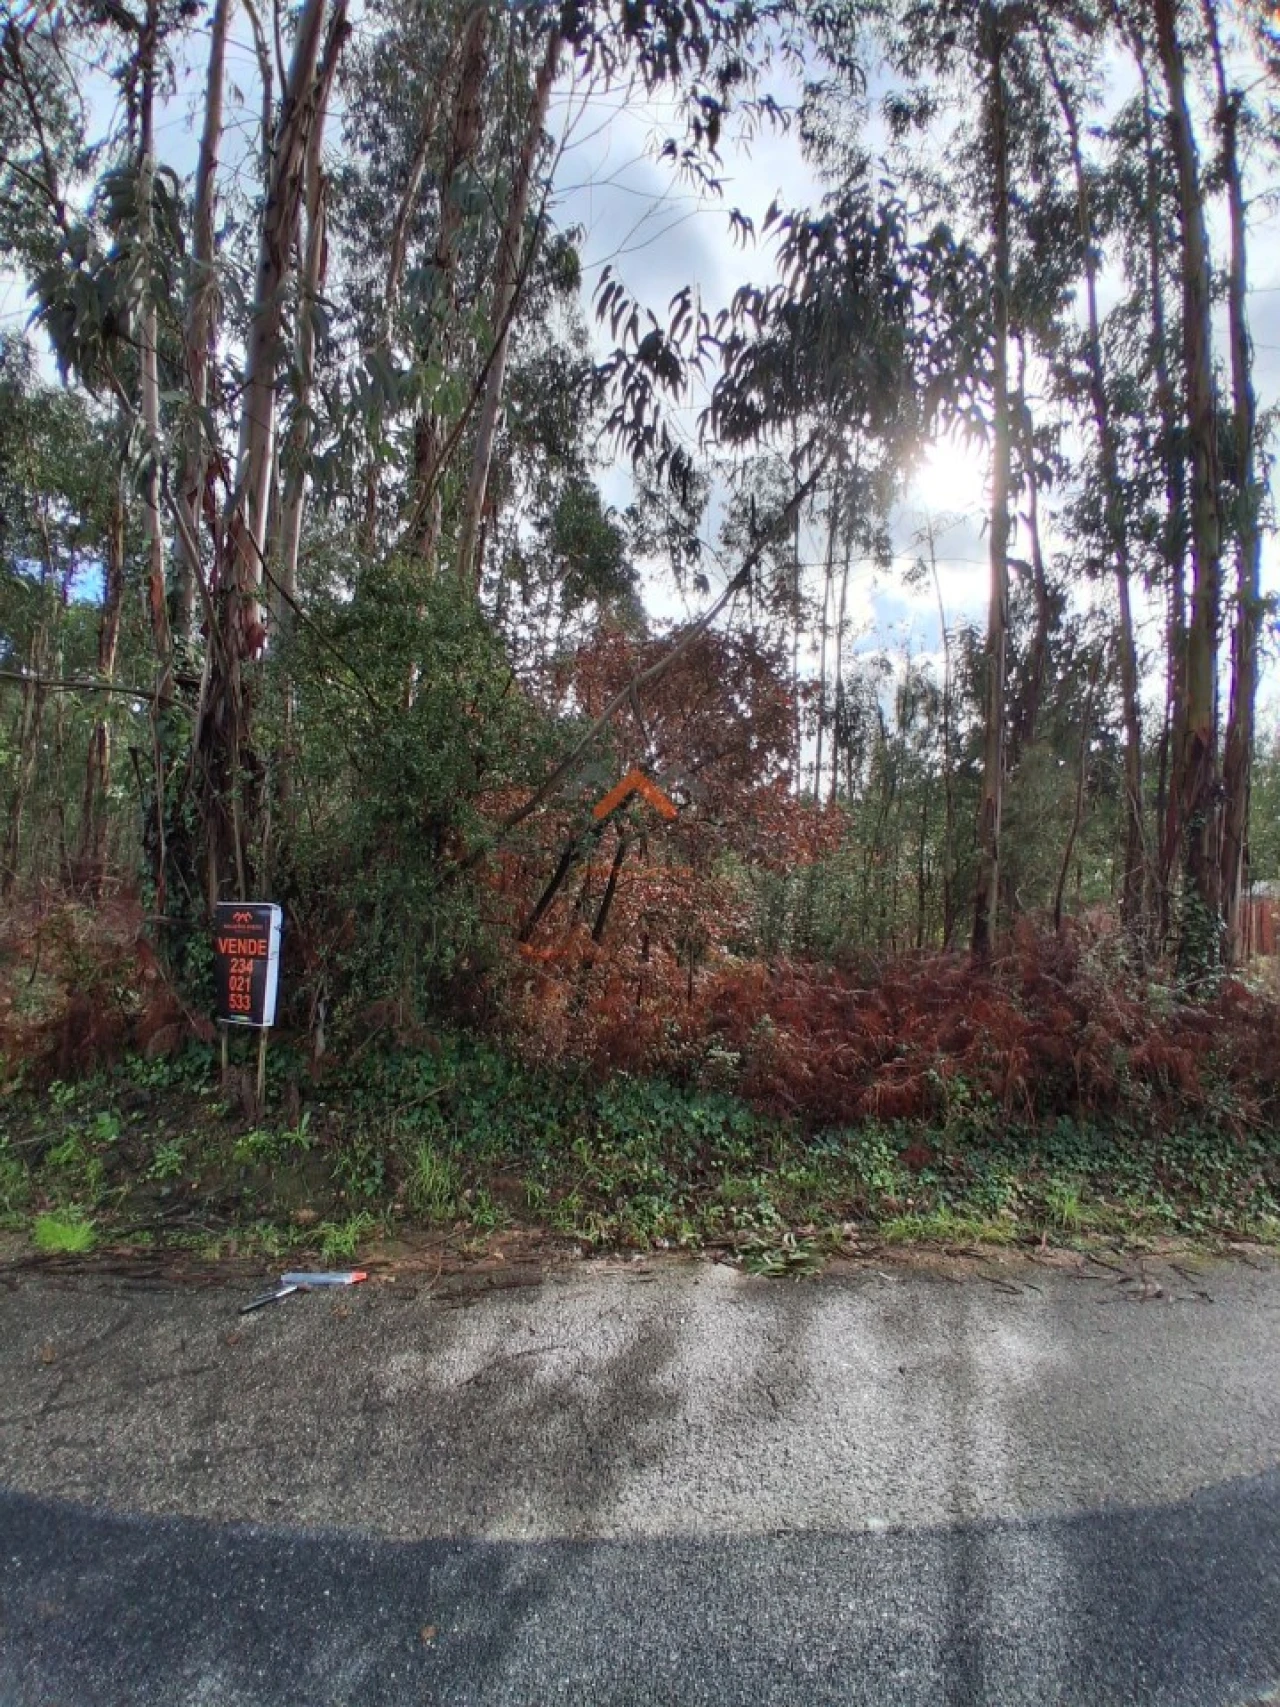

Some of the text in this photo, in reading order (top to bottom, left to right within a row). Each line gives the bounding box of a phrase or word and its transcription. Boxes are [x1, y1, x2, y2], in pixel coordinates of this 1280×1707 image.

[218, 937, 267, 955] VENDE
[230, 958, 253, 974] 234
[229, 975, 251, 992] 021
[228, 993, 251, 1011] 533
